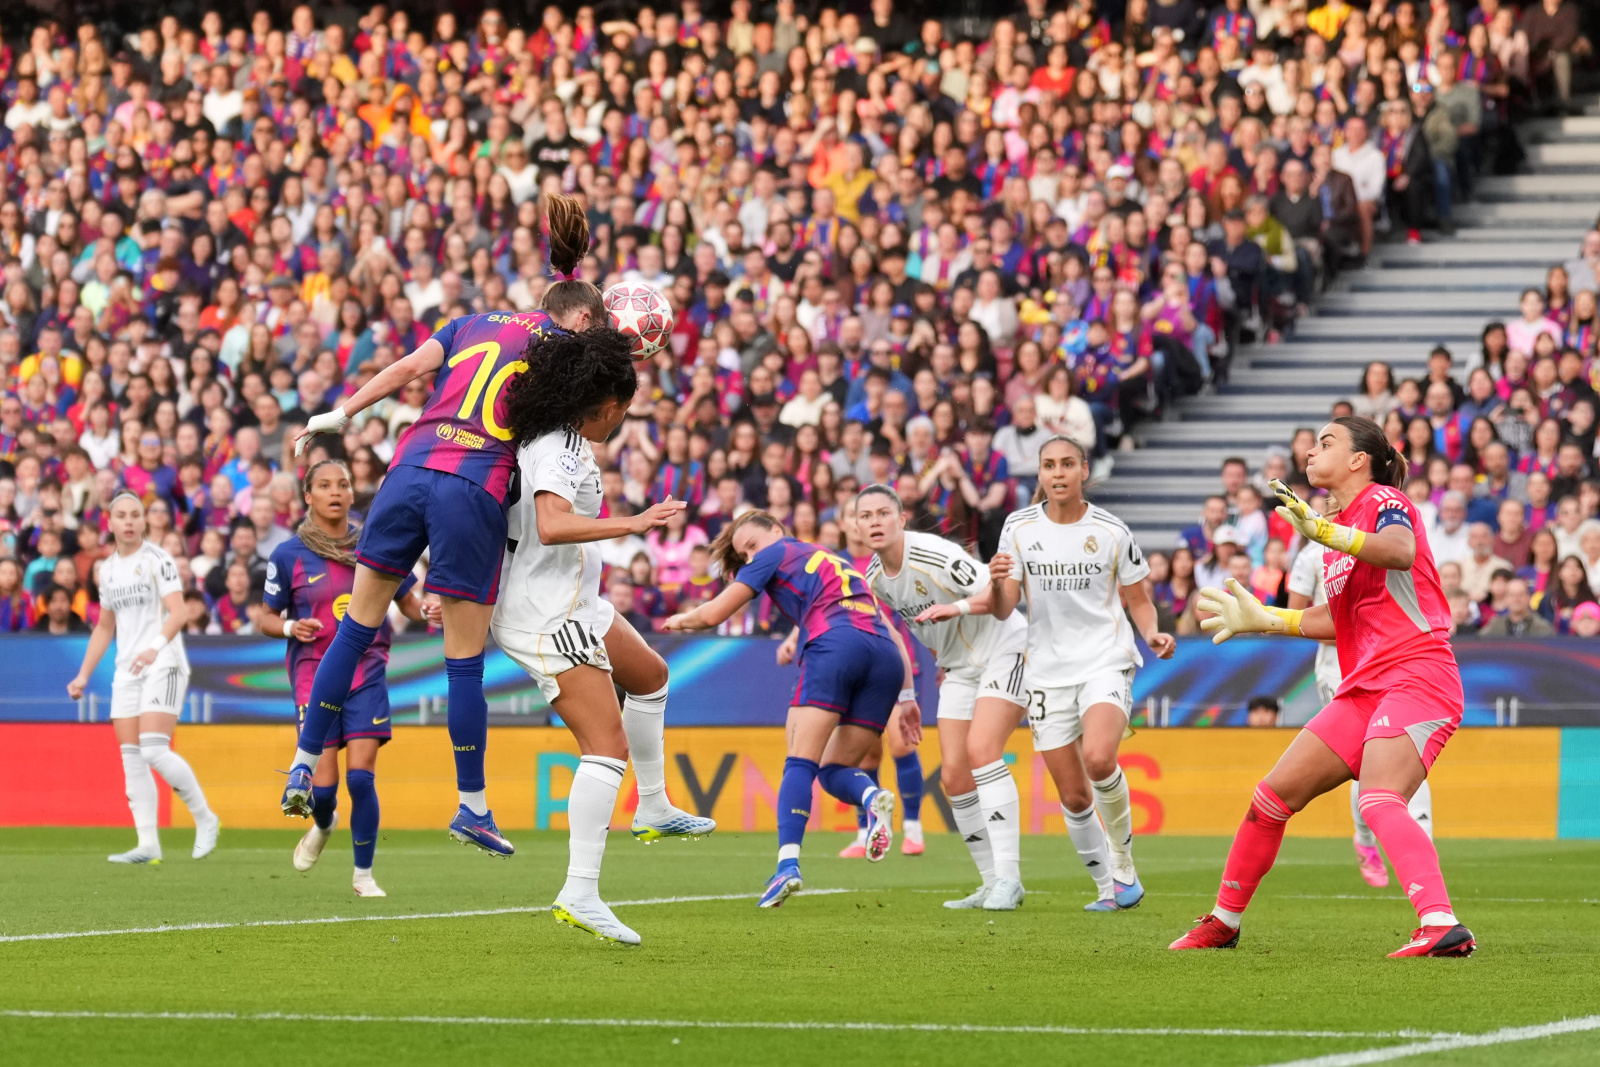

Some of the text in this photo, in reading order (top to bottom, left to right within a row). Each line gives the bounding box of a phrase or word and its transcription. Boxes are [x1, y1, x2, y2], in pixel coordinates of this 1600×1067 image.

[487, 313, 550, 341] GRAHA
[448, 341, 530, 441] 10
[453, 435, 483, 449] ACNUR
[457, 428, 486, 444] UNHCR
[1027, 560, 1102, 576] Emirates
[1056, 578, 1091, 591] BETTER
